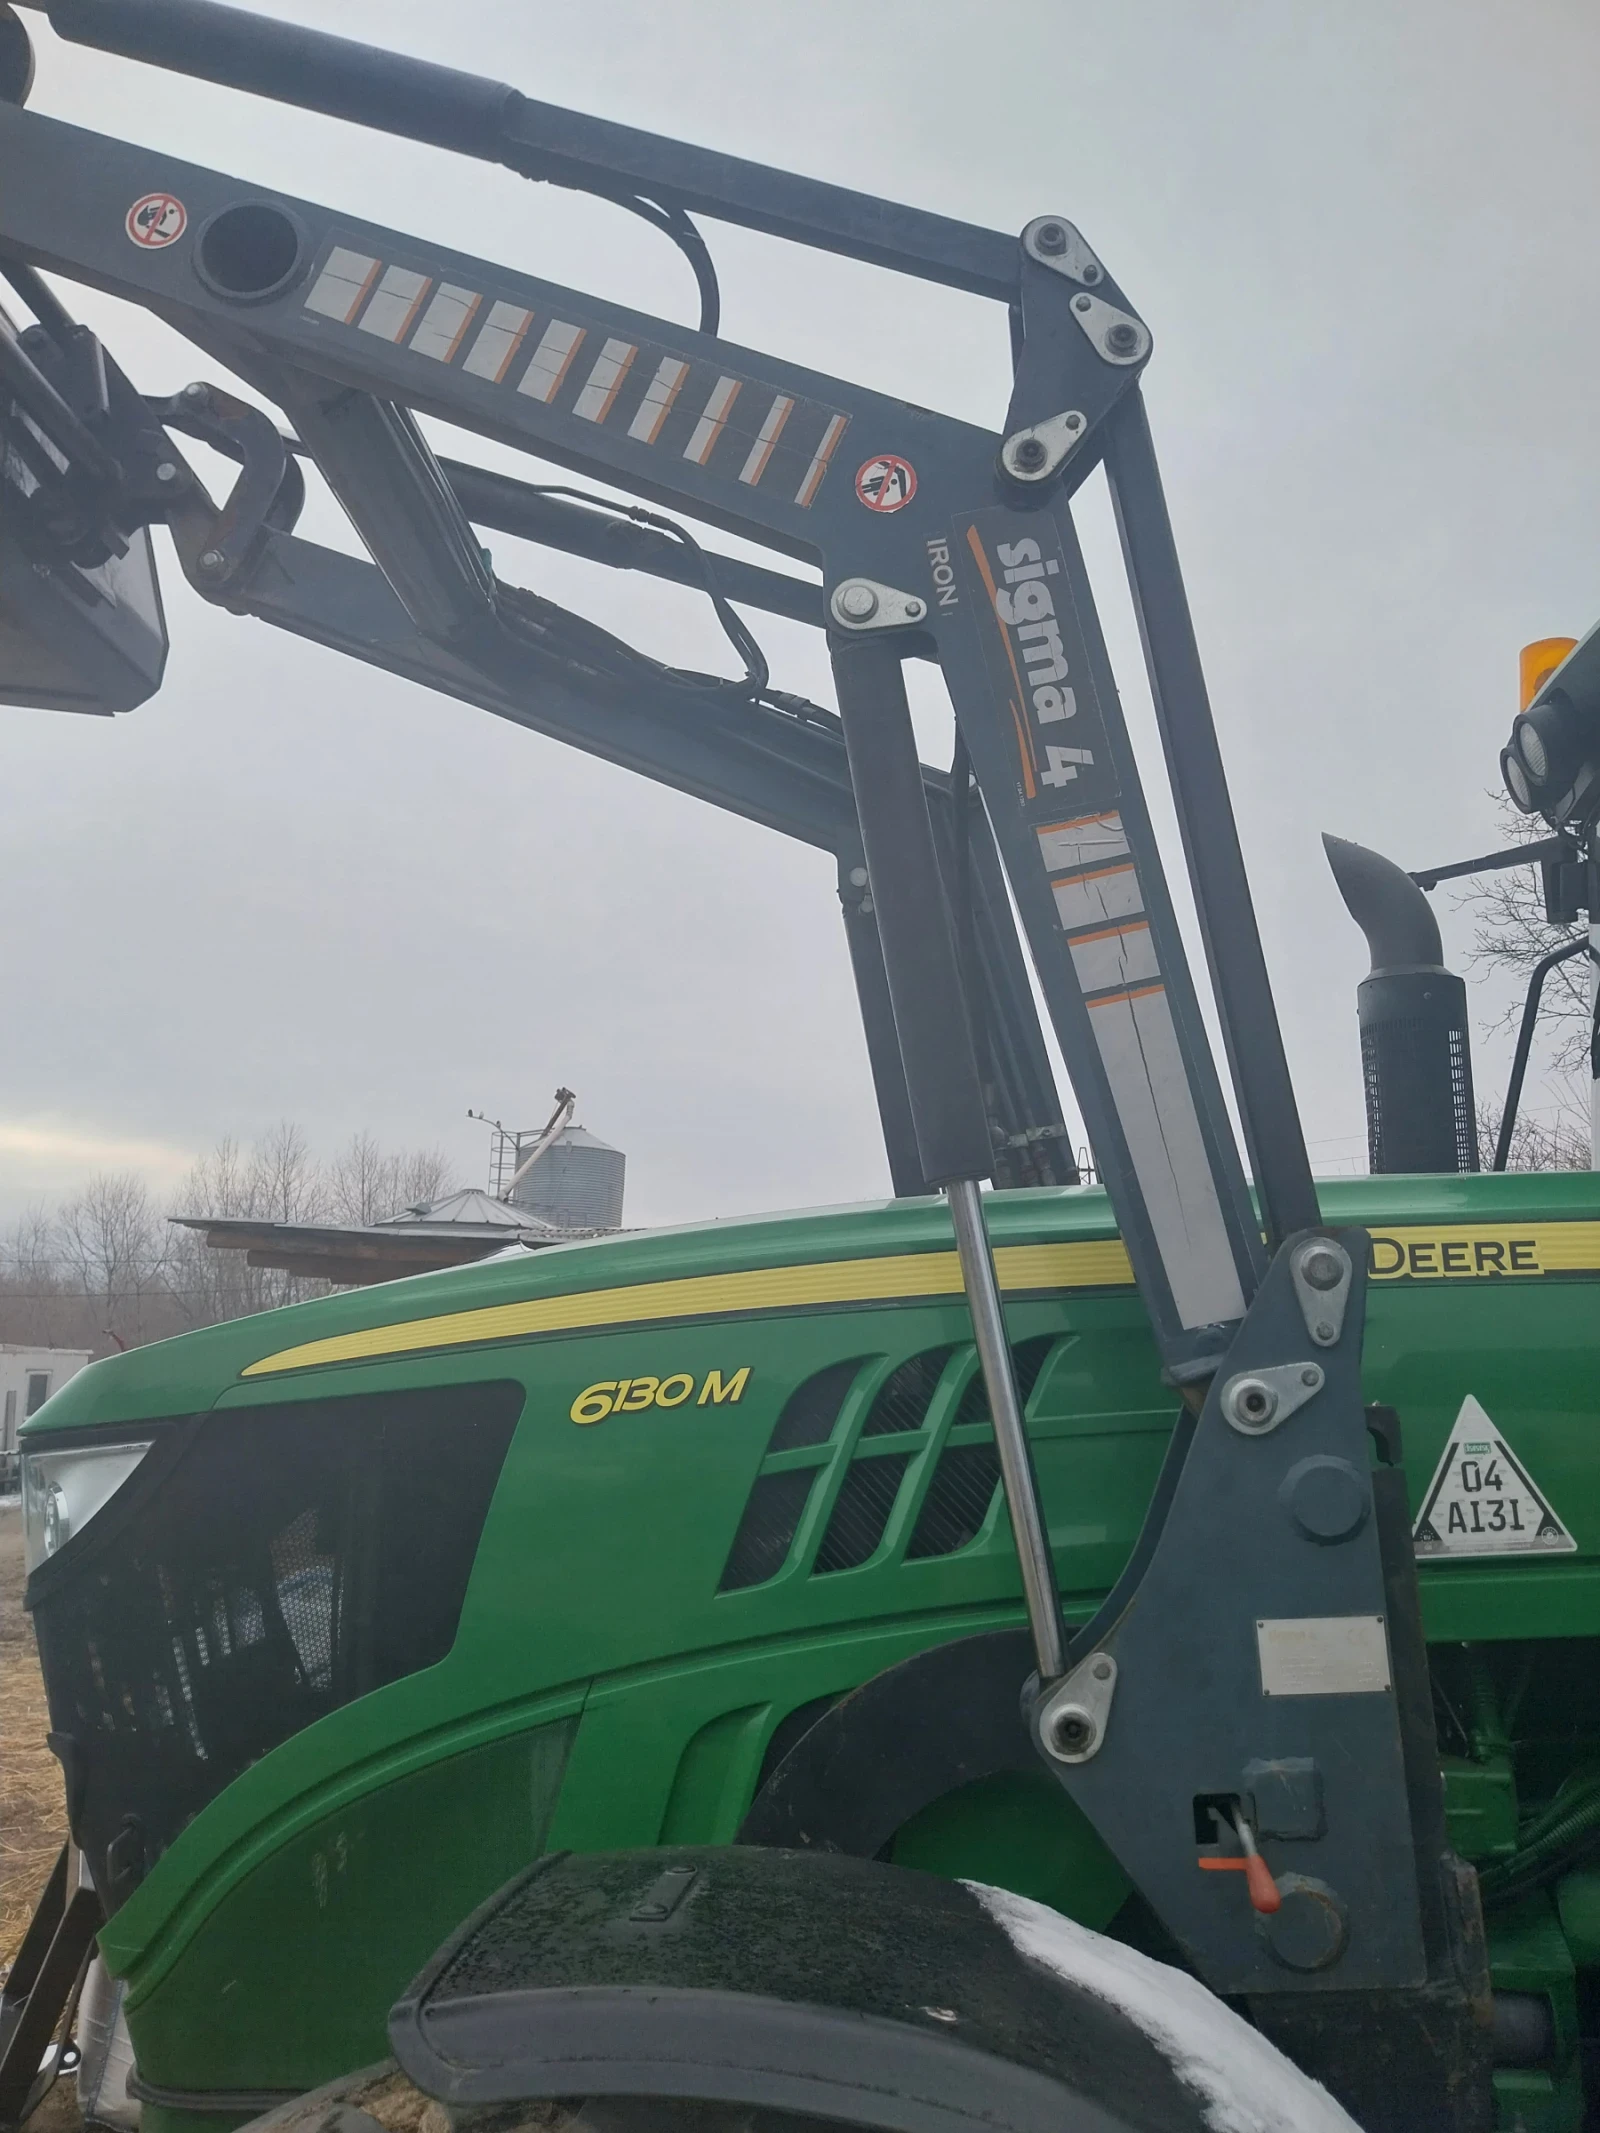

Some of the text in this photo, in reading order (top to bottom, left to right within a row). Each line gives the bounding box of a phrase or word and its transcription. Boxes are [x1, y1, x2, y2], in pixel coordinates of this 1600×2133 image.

[926, 537, 959, 607] IRON
[996, 537, 1095, 789] sigma 4
[1369, 1237, 1540, 1275] DEERE
[569, 1367, 751, 1425] 6130 M
[1460, 1459, 1503, 1493] 04
